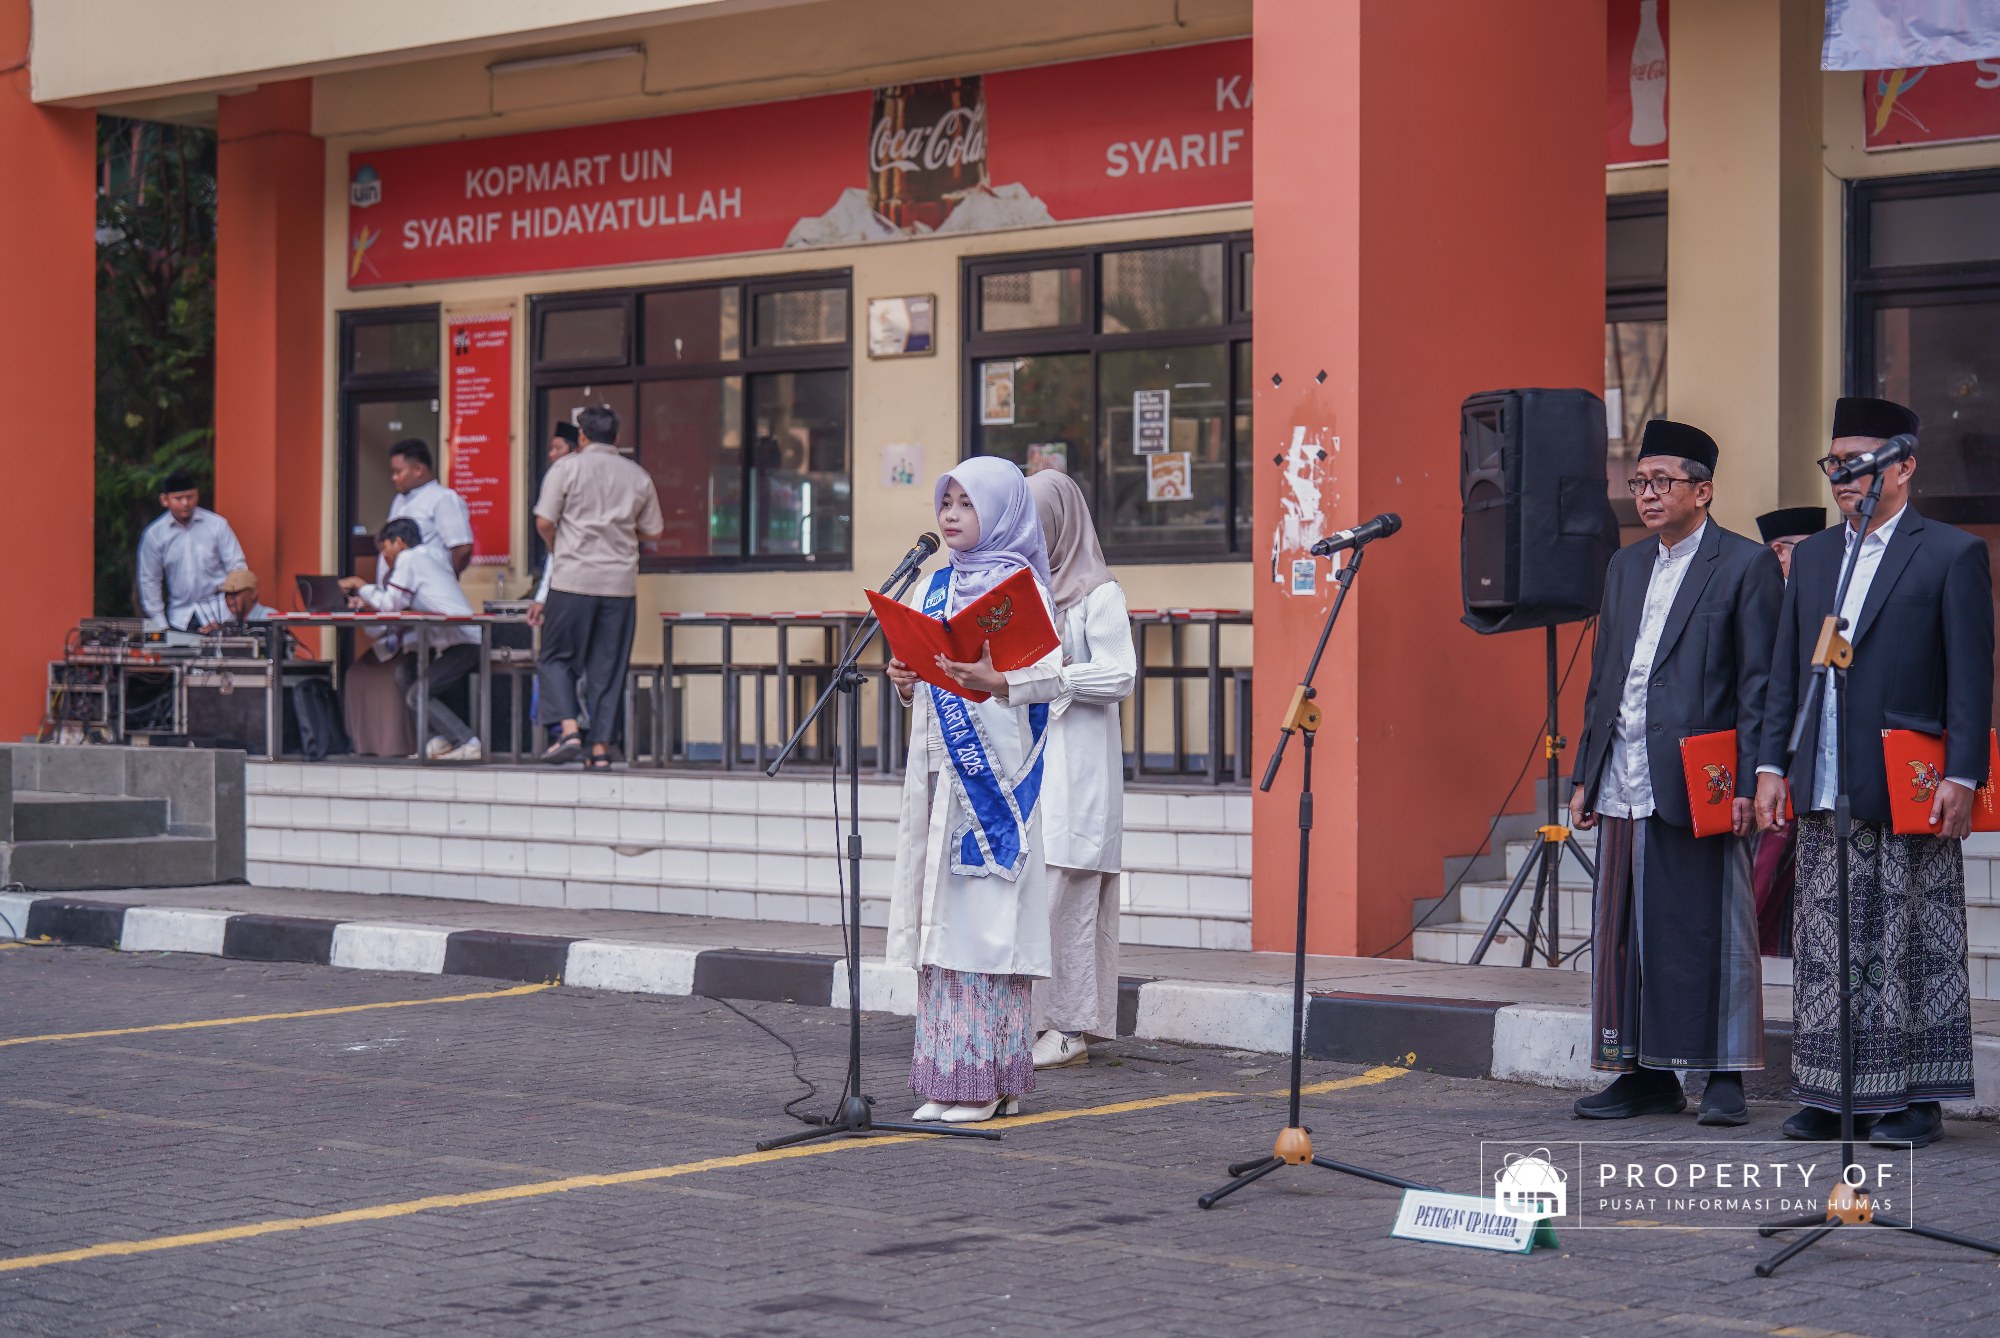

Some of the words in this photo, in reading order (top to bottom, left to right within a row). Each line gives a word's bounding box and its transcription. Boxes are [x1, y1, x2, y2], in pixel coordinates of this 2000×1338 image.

[870, 105, 986, 173] Coca-Cola
[1106, 129, 1244, 178] SYARIF
[465, 154, 612, 200] KOPMART
[619, 147, 673, 183] UIN
[402, 212, 502, 250] SYARIF
[511, 187, 742, 240] HIDAYATULLAH
[957, 743, 985, 776] 2026
[1414, 1204, 1466, 1231] PETUGAS
[1465, 1210, 1519, 1238] UPACARA
